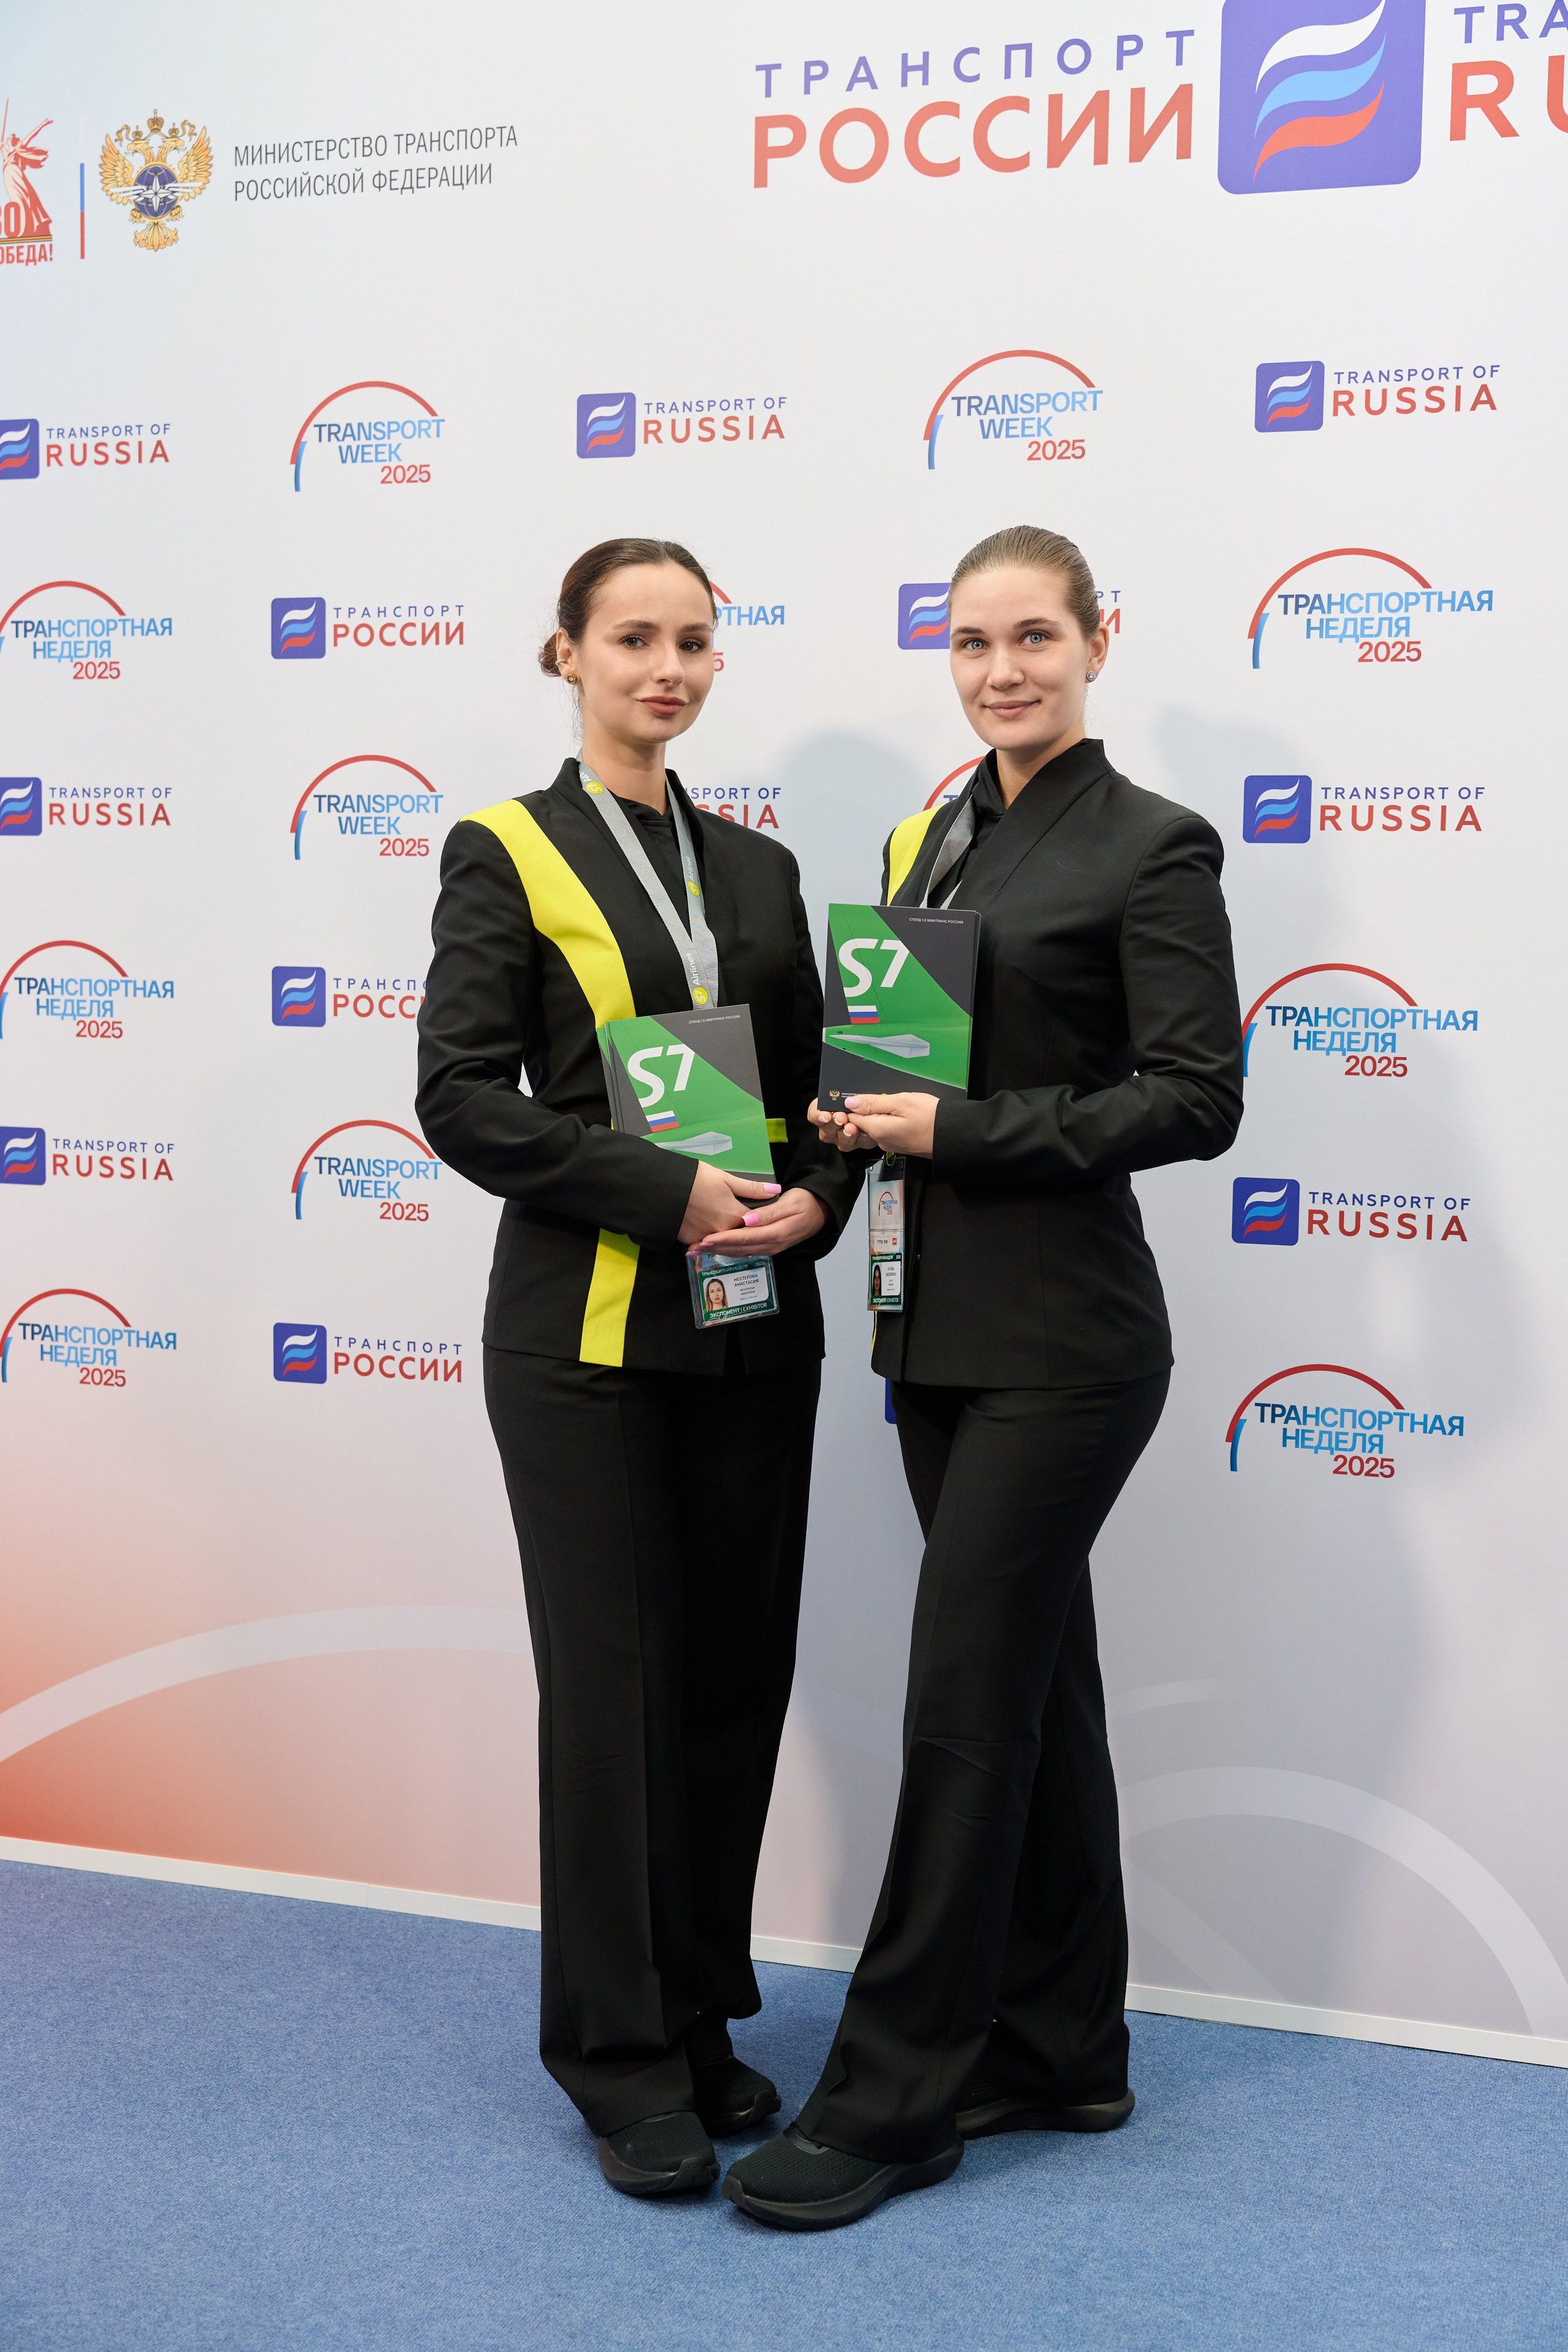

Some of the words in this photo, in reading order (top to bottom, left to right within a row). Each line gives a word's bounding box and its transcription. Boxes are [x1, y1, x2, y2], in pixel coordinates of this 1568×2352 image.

[755, 29, 1194, 98] ТРАНСПОРТ
[235, 135, 386, 167] МИНИСТЕРСТВО
[394, 126, 517, 154] ТРАНСПОРТА
[754, 83, 1193, 189] РОССИИ
[235, 168, 363, 201] РОССИЙСКОЙ
[372, 163, 491, 195] ФЕДЕРАЦИИ
[1334, 367, 1463, 384] TRANSPORT
[1473, 365, 1500, 379] OF
[644, 398, 755, 414] TRANSPORT
[763, 396, 787, 409] OF
[952, 390, 1103, 417] TRANSPORT
[1333, 384, 1496, 417] RUSSIA
[47, 424, 143, 437] TRANSPORT
[151, 423, 170, 435] OF
[314, 418, 445, 443] TRANSPORT
[644, 415, 785, 444] RUSSIA
[979, 417, 1052, 439] WEEK
[47, 440, 169, 467] RUSSIA
[339, 443, 402, 464] WEEK
[1027, 439, 1085, 461] 2025
[380, 464, 431, 484] 2025
[333, 605, 464, 619] ТРАНСПОРТ
[1278, 590, 1493, 616] ТРАНСПОРТНАЯ
[12, 617, 172, 638] ТРАНСПОРТНАЯ
[333, 621, 464, 647] РОССИИ
[1306, 616, 1410, 643] НЕДЕЛЯ
[33, 640, 111, 663] НЕДЕЛЯ
[1358, 641, 1421, 662] 2025
[73, 661, 121, 680] 2025
[49, 786, 145, 799] TRANSPORT
[152, 787, 172, 798] OF
[314, 794, 443, 813] TRANSPORT
[758, 788, 781, 799] OF
[1321, 787, 1449, 800] TRANSPORT
[1458, 787, 1485, 800] OF
[49, 802, 170, 826] RUSSIA
[1320, 805, 1481, 832] RUSSIA
[338, 816, 401, 835] WEEK
[379, 837, 429, 856] 2025
[686, 952, 701, 986] Airlines
[839, 938, 910, 998] S7
[15, 978, 174, 998] ТРАНСПОРТНАЯ
[36, 998, 113, 1020] НЕДЕЛЯ
[333, 993, 424, 1019] РОСС
[75, 1020, 123, 1039] 2025
[1266, 1006, 1478, 1031] ТРАНСПОРТНАЯ
[1294, 1030, 1396, 1056] НЕДЕЛЯ
[628, 1044, 695, 1107] S7
[1345, 1055, 1408, 1077] 2025
[54, 1138, 148, 1153] TRANSPORT
[154, 1142, 174, 1155] OF
[53, 1153, 173, 1181] RUSSIA
[315, 1157, 442, 1180] TRANSPORT
[339, 1179, 401, 1199] WEEK
[1308, 1191, 1434, 1209] TRANSPORT
[1444, 1197, 1470, 1210] OF
[380, 1202, 429, 1222] 2025
[1308, 1209, 1467, 1242] RUSSIA
[702, 1268, 733, 1276] ТРАНСПОРТНАЯ
[734, 1278, 759, 1287] АНАСТАСИЯ
[710, 1308, 740, 1318] ЭКСПОНЕНТ
[743, 1303, 767, 1311] EXHIBITOR
[19, 1323, 176, 1351] ТРАНСПОРТНАЯ
[334, 1336, 461, 1355] ТРАНСПОРТ
[40, 1344, 116, 1367] НЕДЕЛЯ
[79, 1367, 126, 1387] 2025
[334, 1352, 461, 1382] РОССИИ
[1256, 1403, 1464, 1436] ТРАНСПОРТНАЯ
[1283, 1428, 1383, 1455] НЕДЕЛЯ
[1333, 1455, 1395, 1478] 2025
